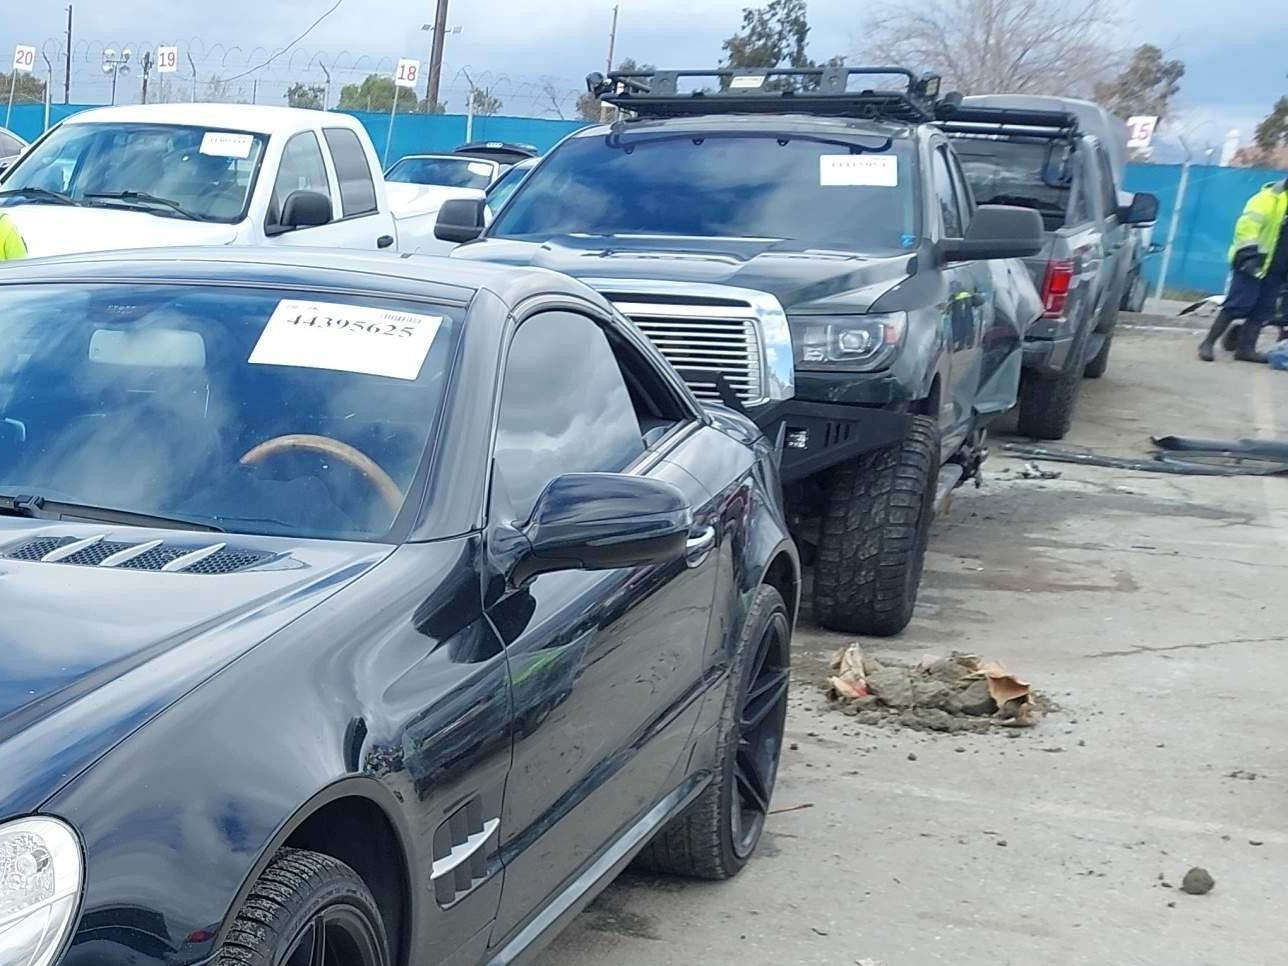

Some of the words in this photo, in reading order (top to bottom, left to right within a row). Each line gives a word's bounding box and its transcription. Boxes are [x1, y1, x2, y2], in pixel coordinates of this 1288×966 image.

[15, 49, 33, 66] 20
[159, 52, 175, 67] 19
[397, 64, 416, 81] 18
[287, 314, 416, 338] 44395625
